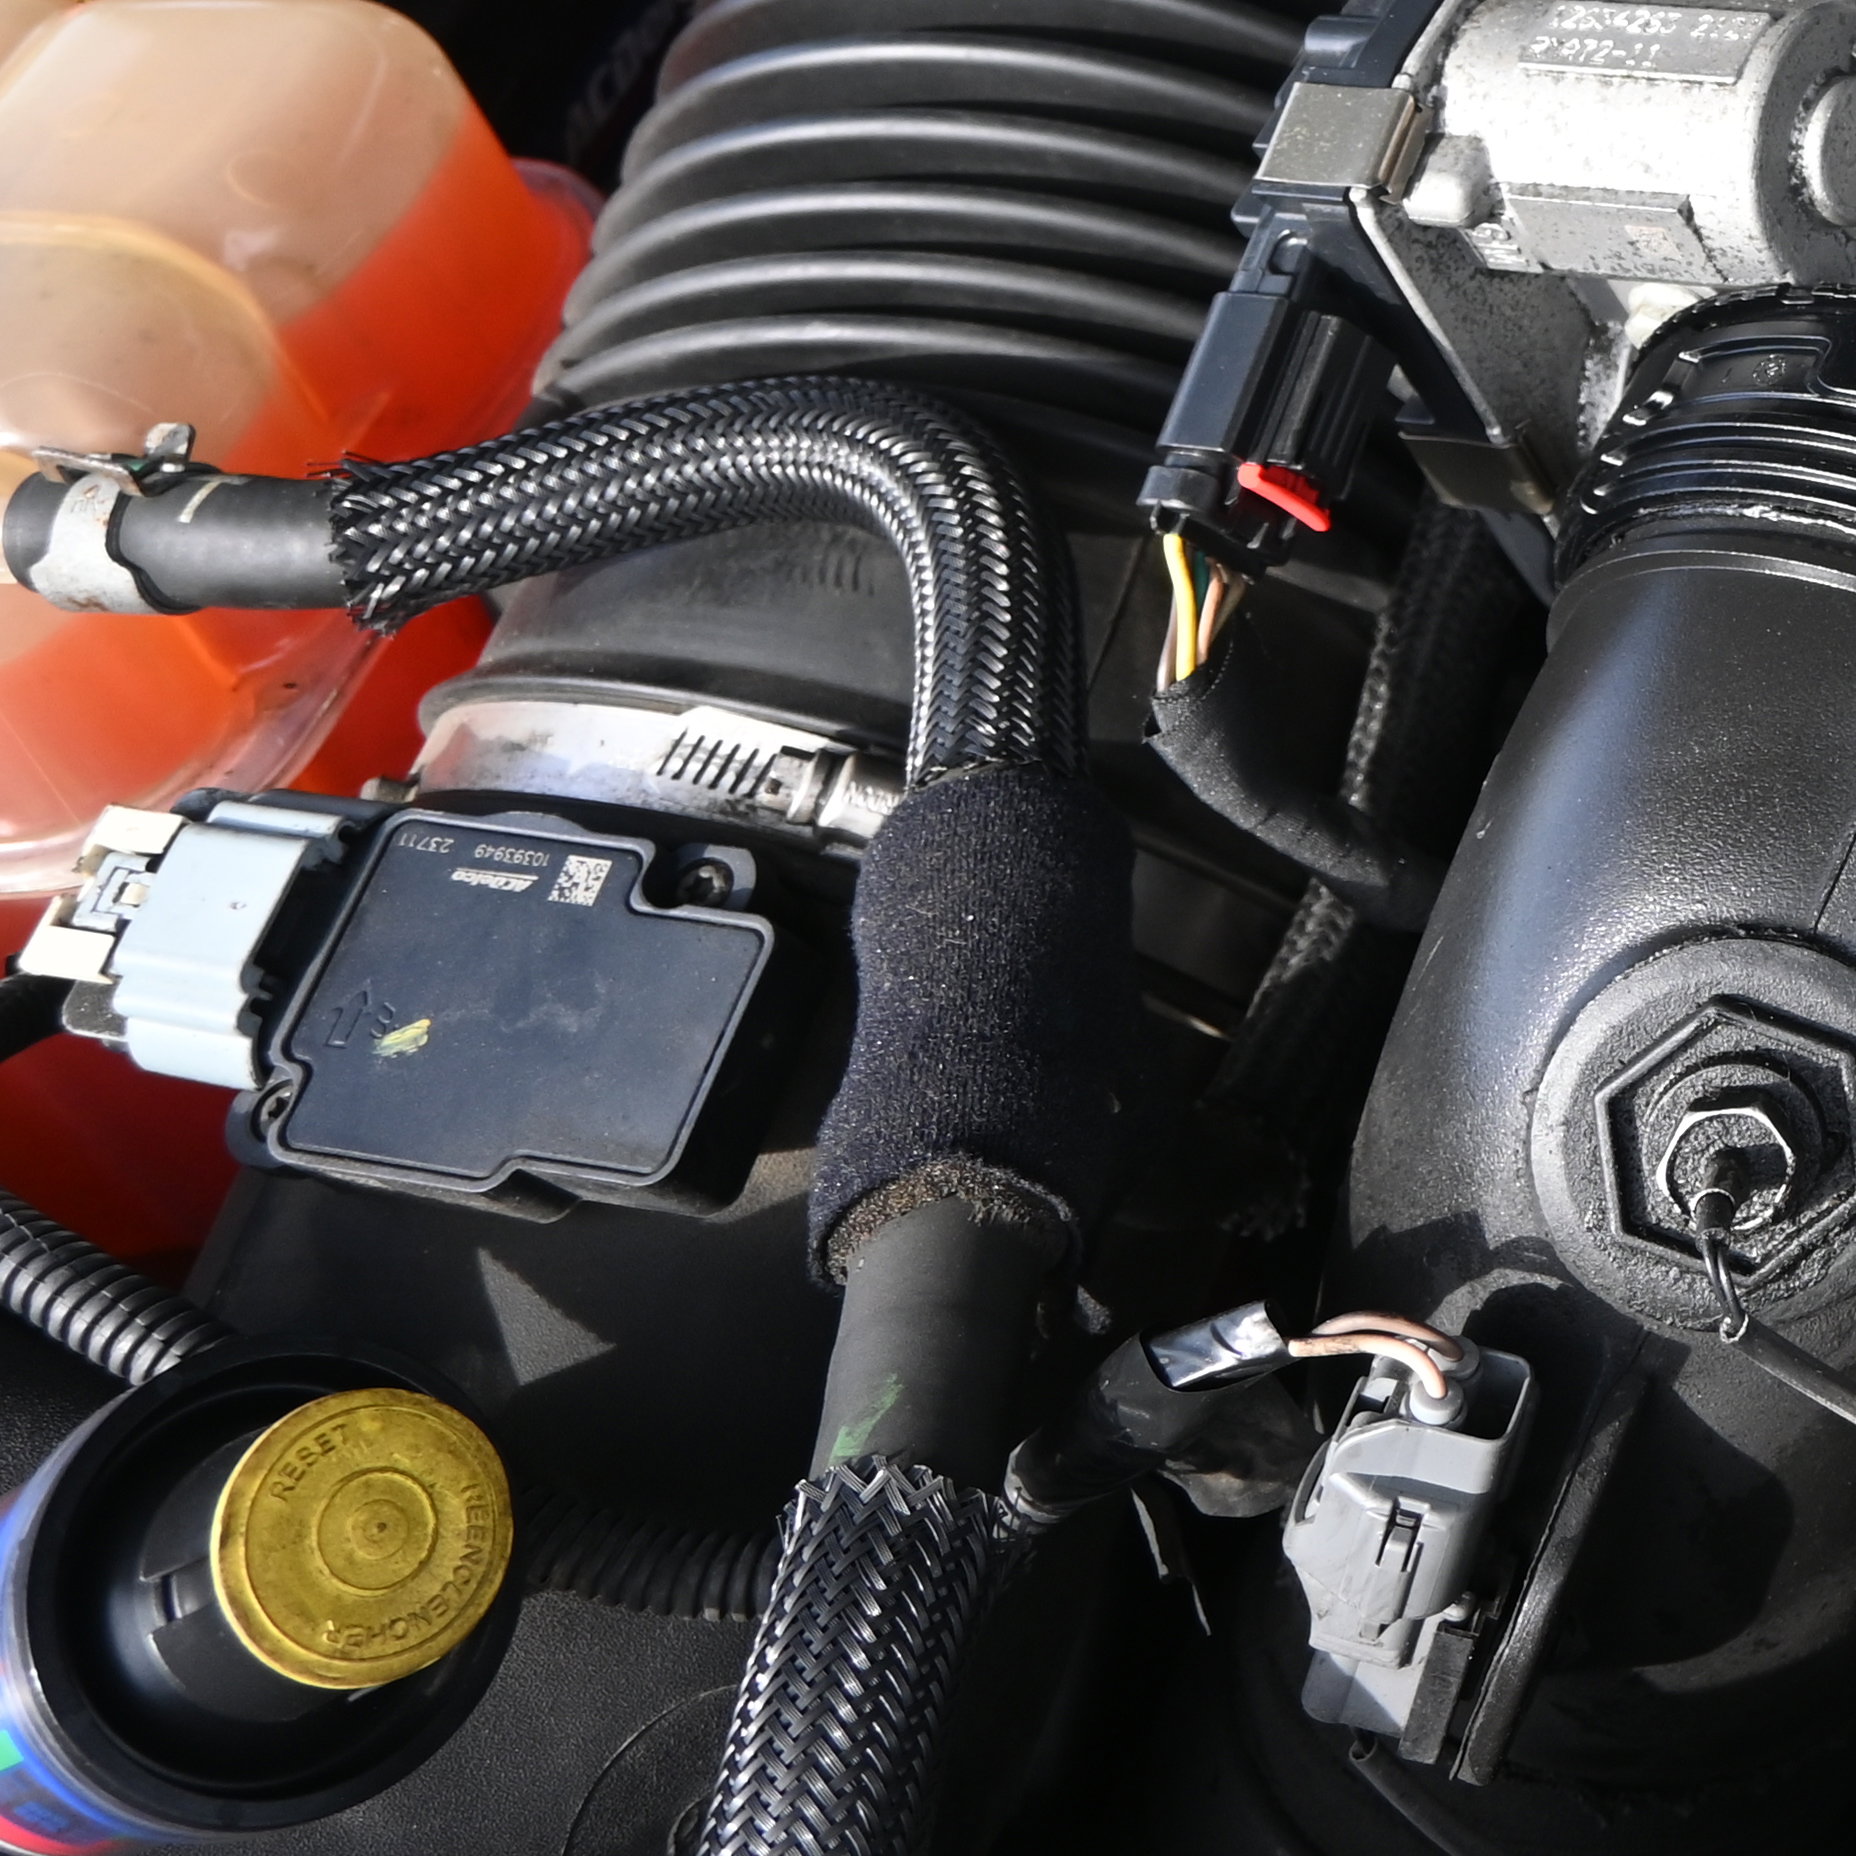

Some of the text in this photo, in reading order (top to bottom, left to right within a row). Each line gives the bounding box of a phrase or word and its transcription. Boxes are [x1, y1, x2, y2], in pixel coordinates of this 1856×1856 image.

[397, 831, 550, 867] 10393949 23711
[450, 867, 539, 893] ACDelco
[269, 1422, 349, 1502] RESET
[321, 1482, 492, 1650] REENCLENCHER
